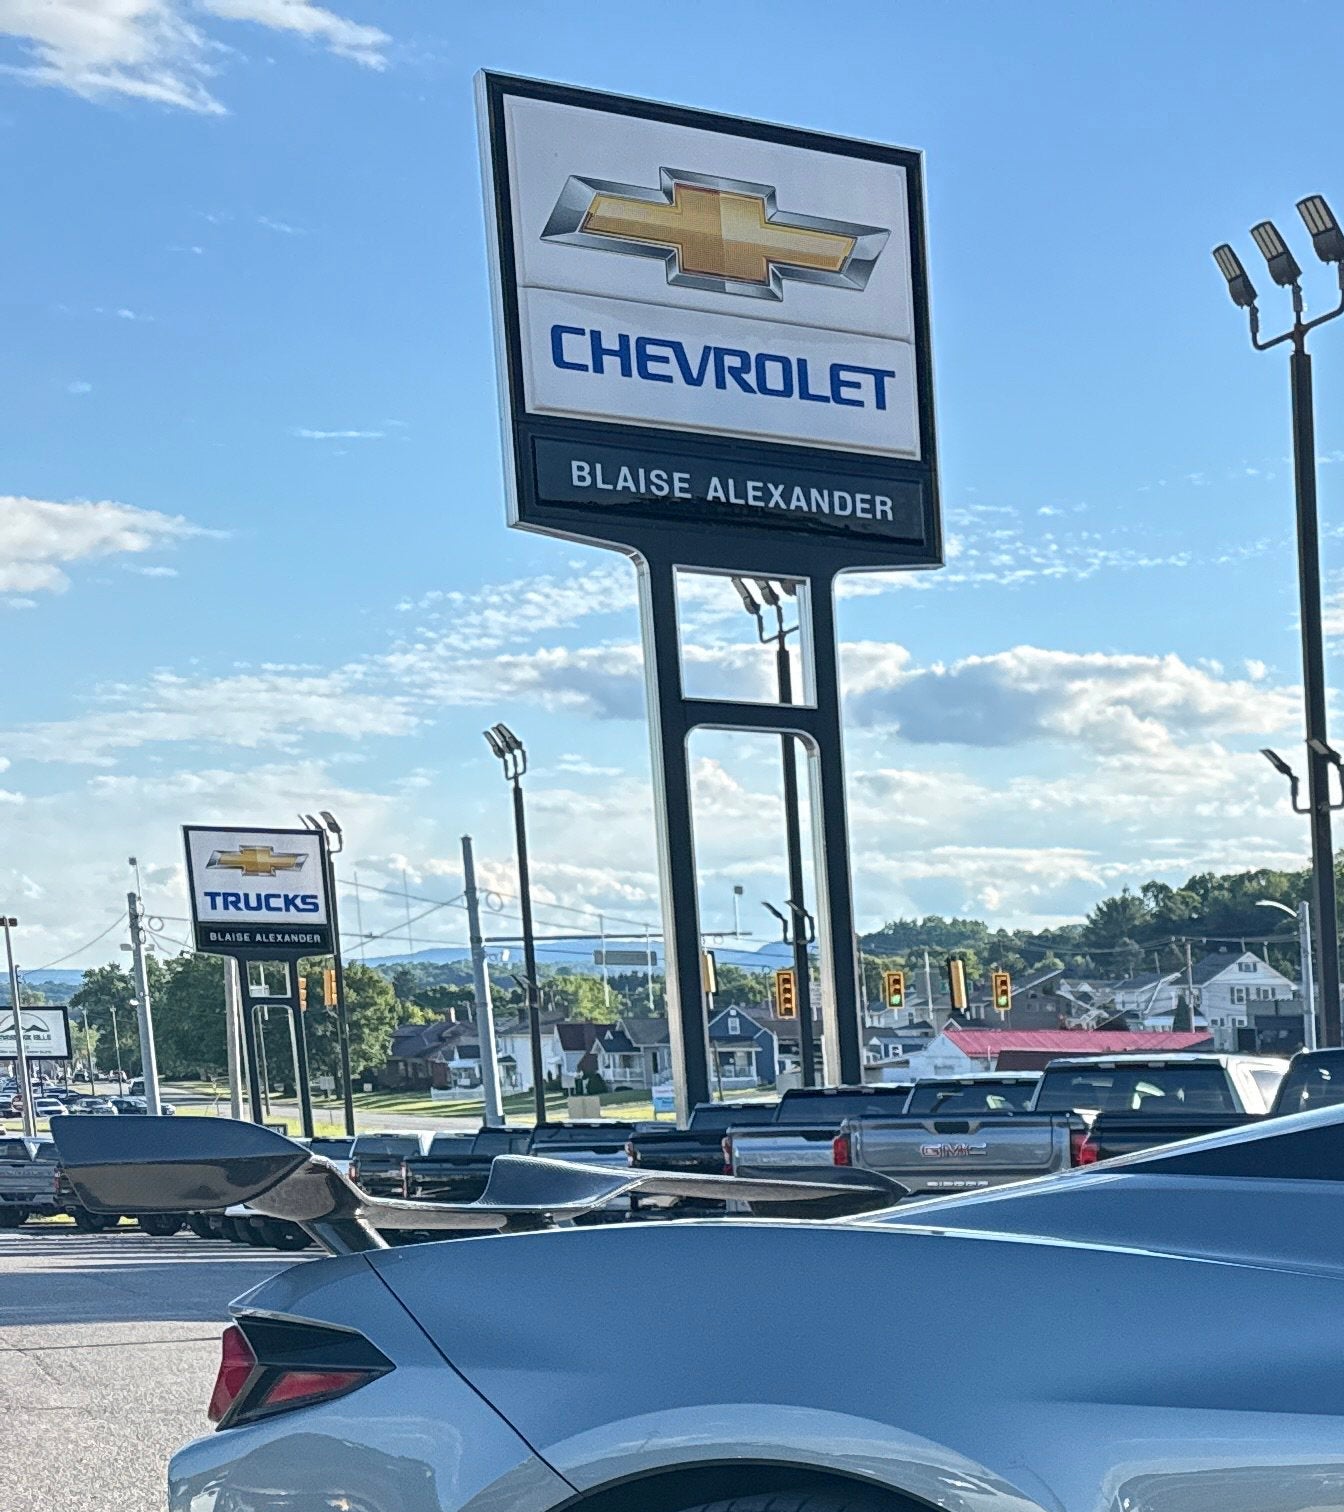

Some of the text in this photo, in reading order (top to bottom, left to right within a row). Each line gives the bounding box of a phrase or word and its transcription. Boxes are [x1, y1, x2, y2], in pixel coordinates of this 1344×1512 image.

[550, 324, 896, 411] CHEVROLET
[571, 460, 893, 521] BLAISE ALEXANDER
[204, 891, 320, 913] TRUCKS
[210, 932, 321, 943] BLAISE ALEXANDER
[920, 1143, 987, 1158] GMC
